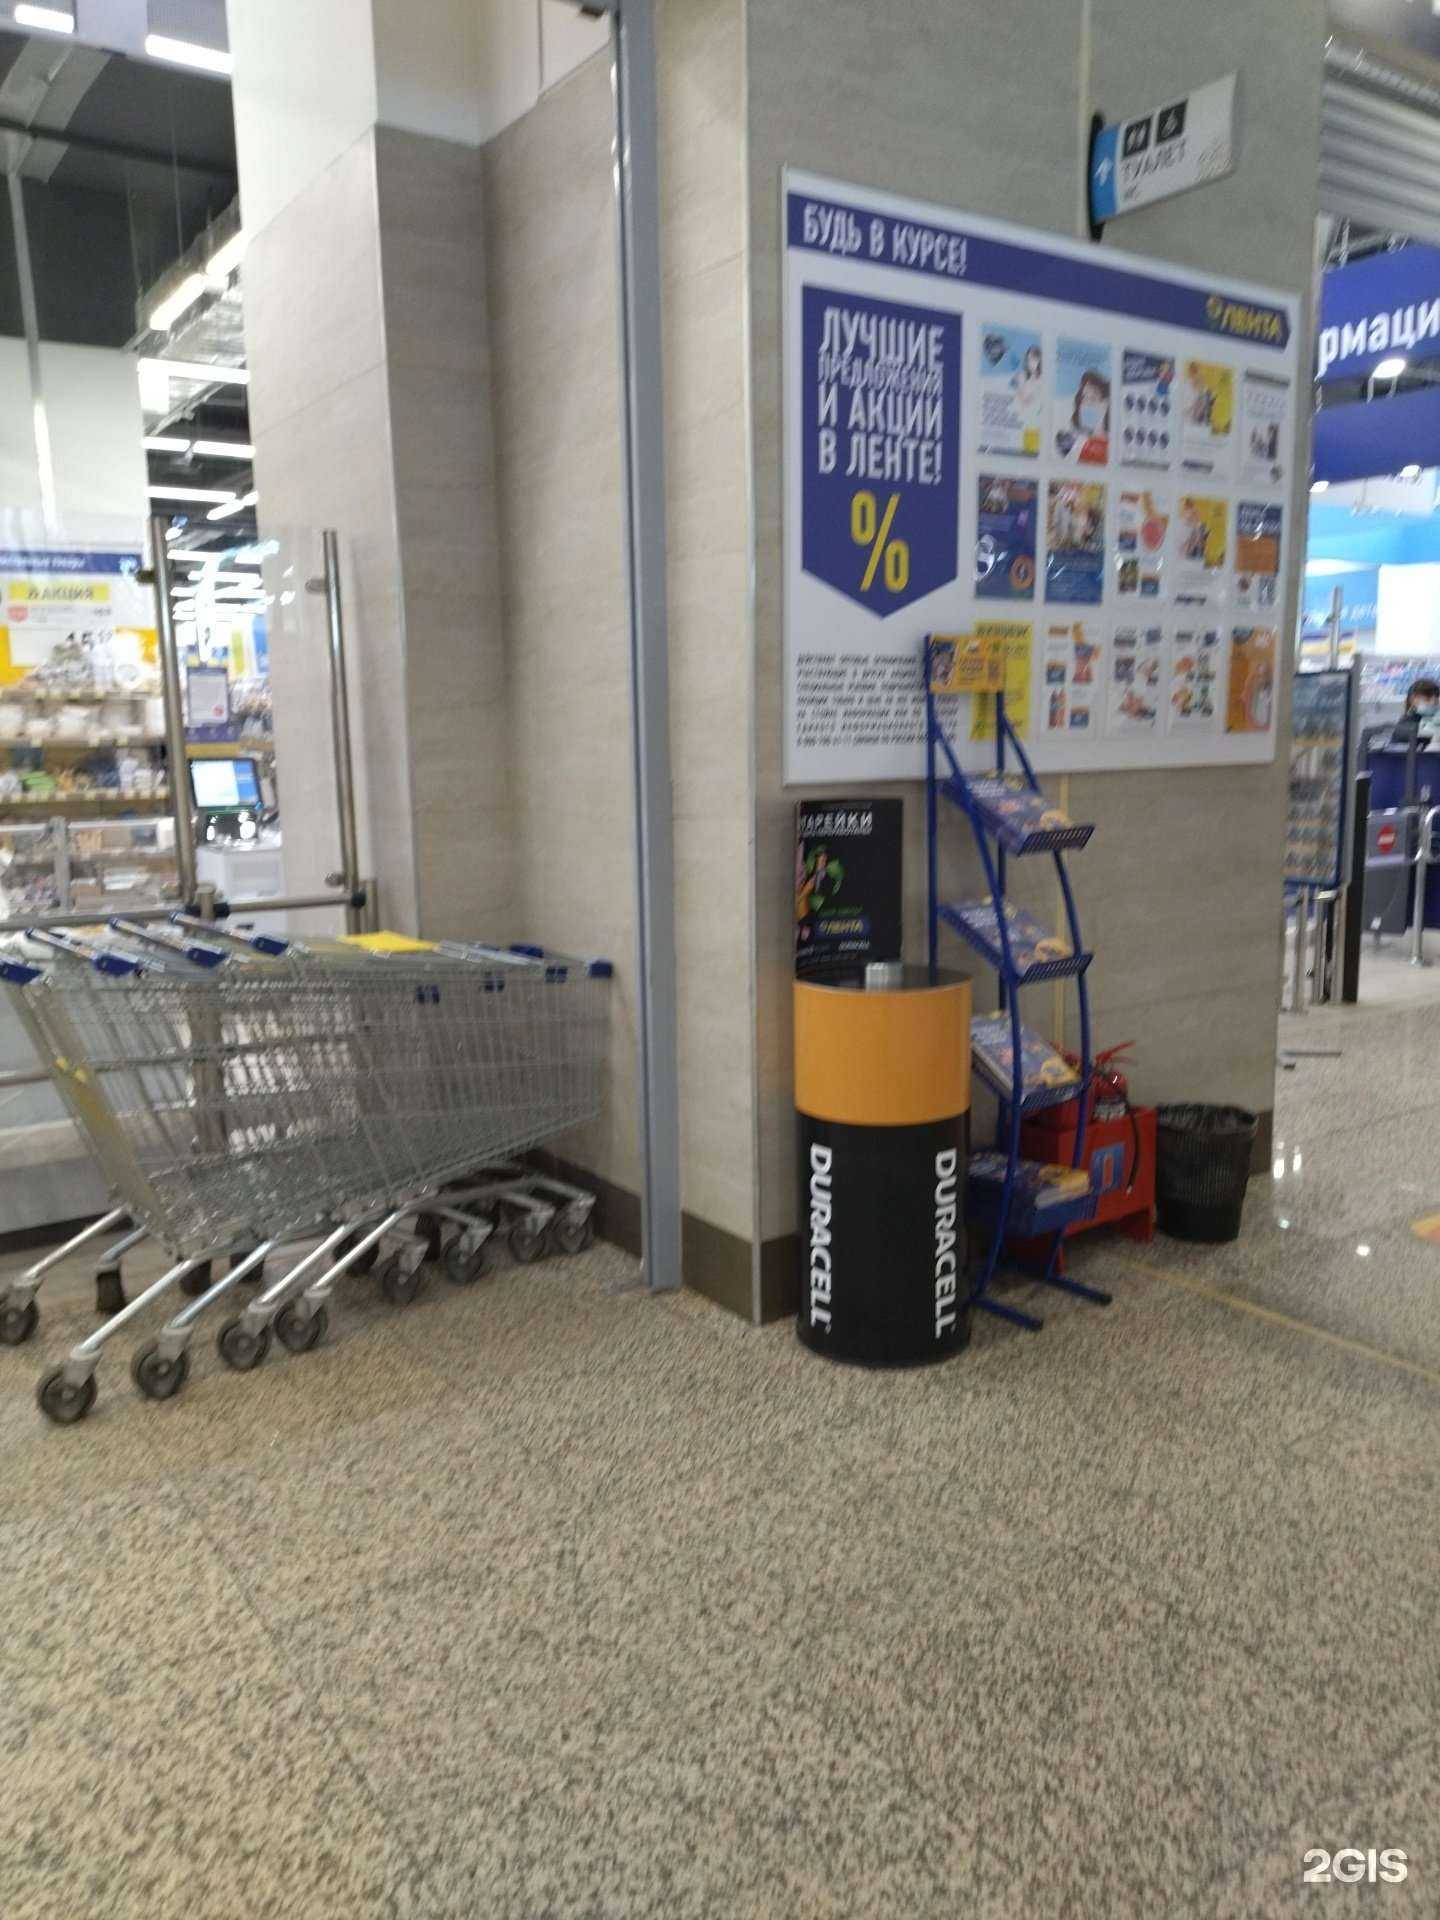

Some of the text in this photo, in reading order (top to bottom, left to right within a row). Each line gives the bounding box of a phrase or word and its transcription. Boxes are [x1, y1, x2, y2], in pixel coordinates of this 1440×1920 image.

[803, 202, 968, 276] БУДЬ В КУРСЕ!
[818, 305, 944, 372] ЛУЧШИЕ
[818, 381, 838, 427] И
[847, 384, 943, 439] АКЦИИ
[818, 427, 942, 485] В ЛЕНТЕ!
[810, 1143, 833, 1332] DURACELL
[935, 1148, 957, 1339] DURACELL
